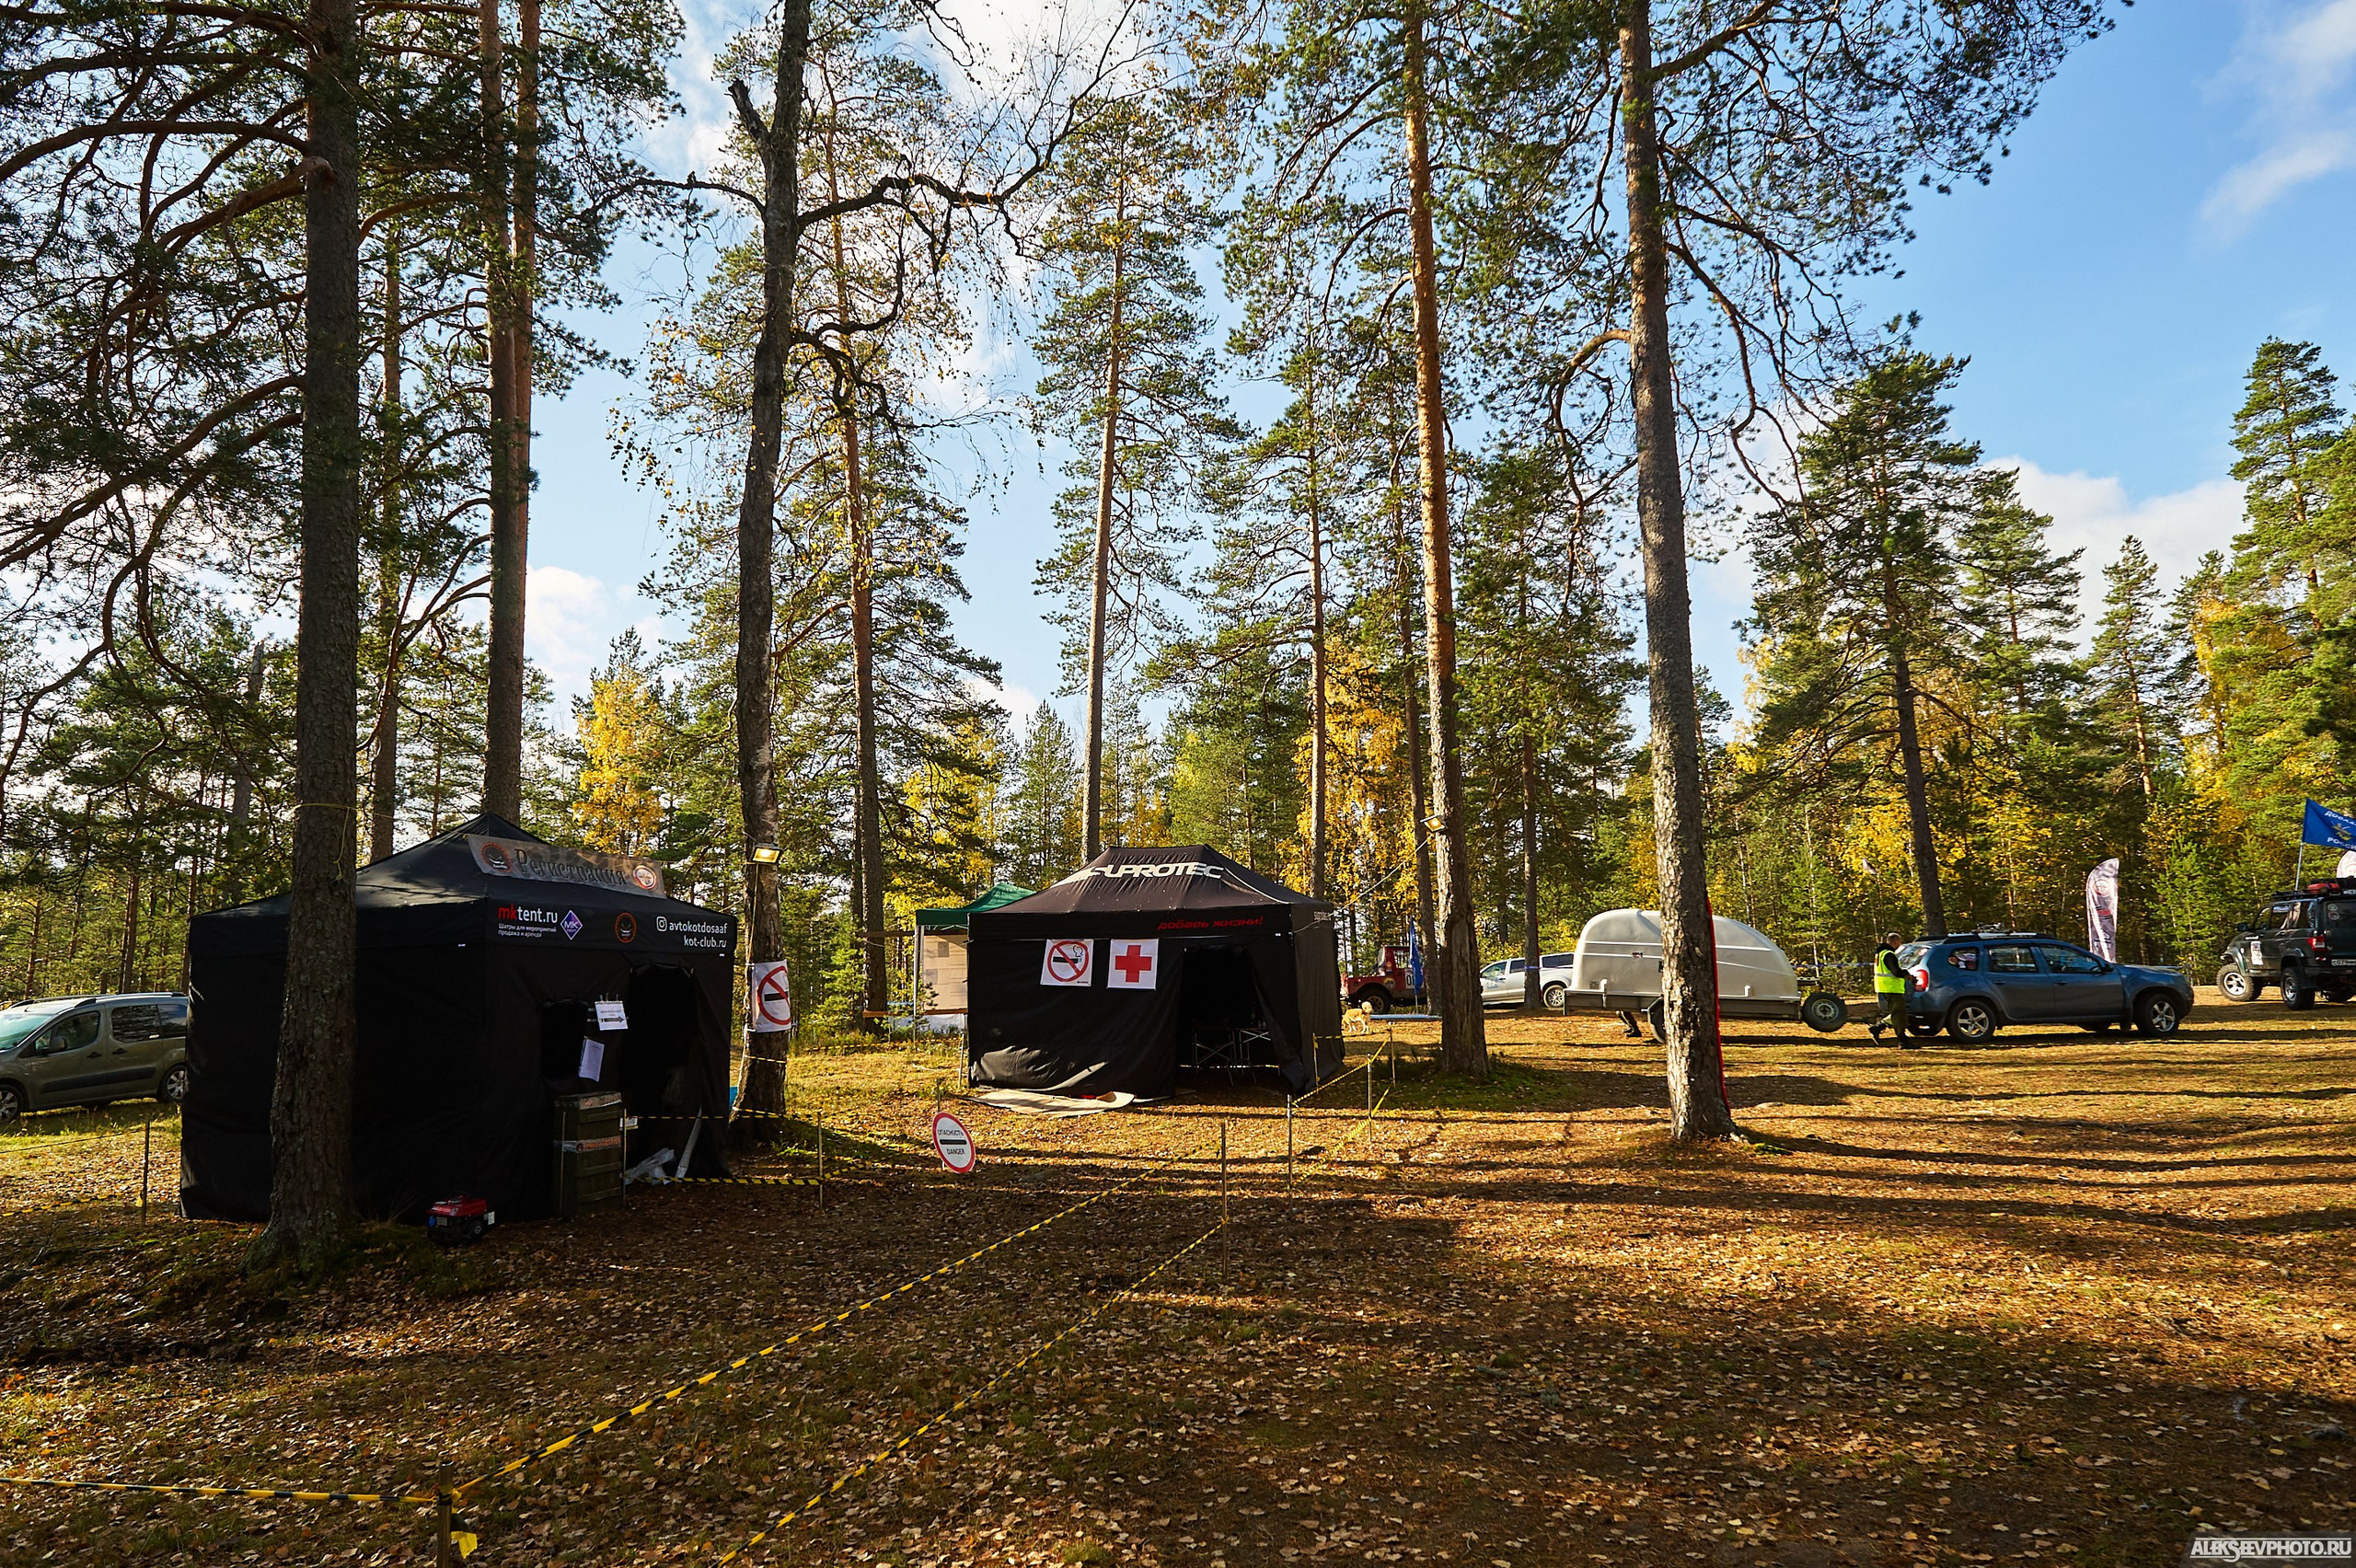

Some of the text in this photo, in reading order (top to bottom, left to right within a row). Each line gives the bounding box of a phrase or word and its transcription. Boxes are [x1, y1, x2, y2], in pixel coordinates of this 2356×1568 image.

[514, 847, 629, 885] Регистрация
[1058, 861, 1224, 885] SUPROTEC
[498, 904, 558, 924] mktent.ru
[669, 921, 728, 933] avtokotdosaaf
[1157, 917, 1264, 930] добавь жизни!
[684, 935, 726, 948] kot-club.ru
